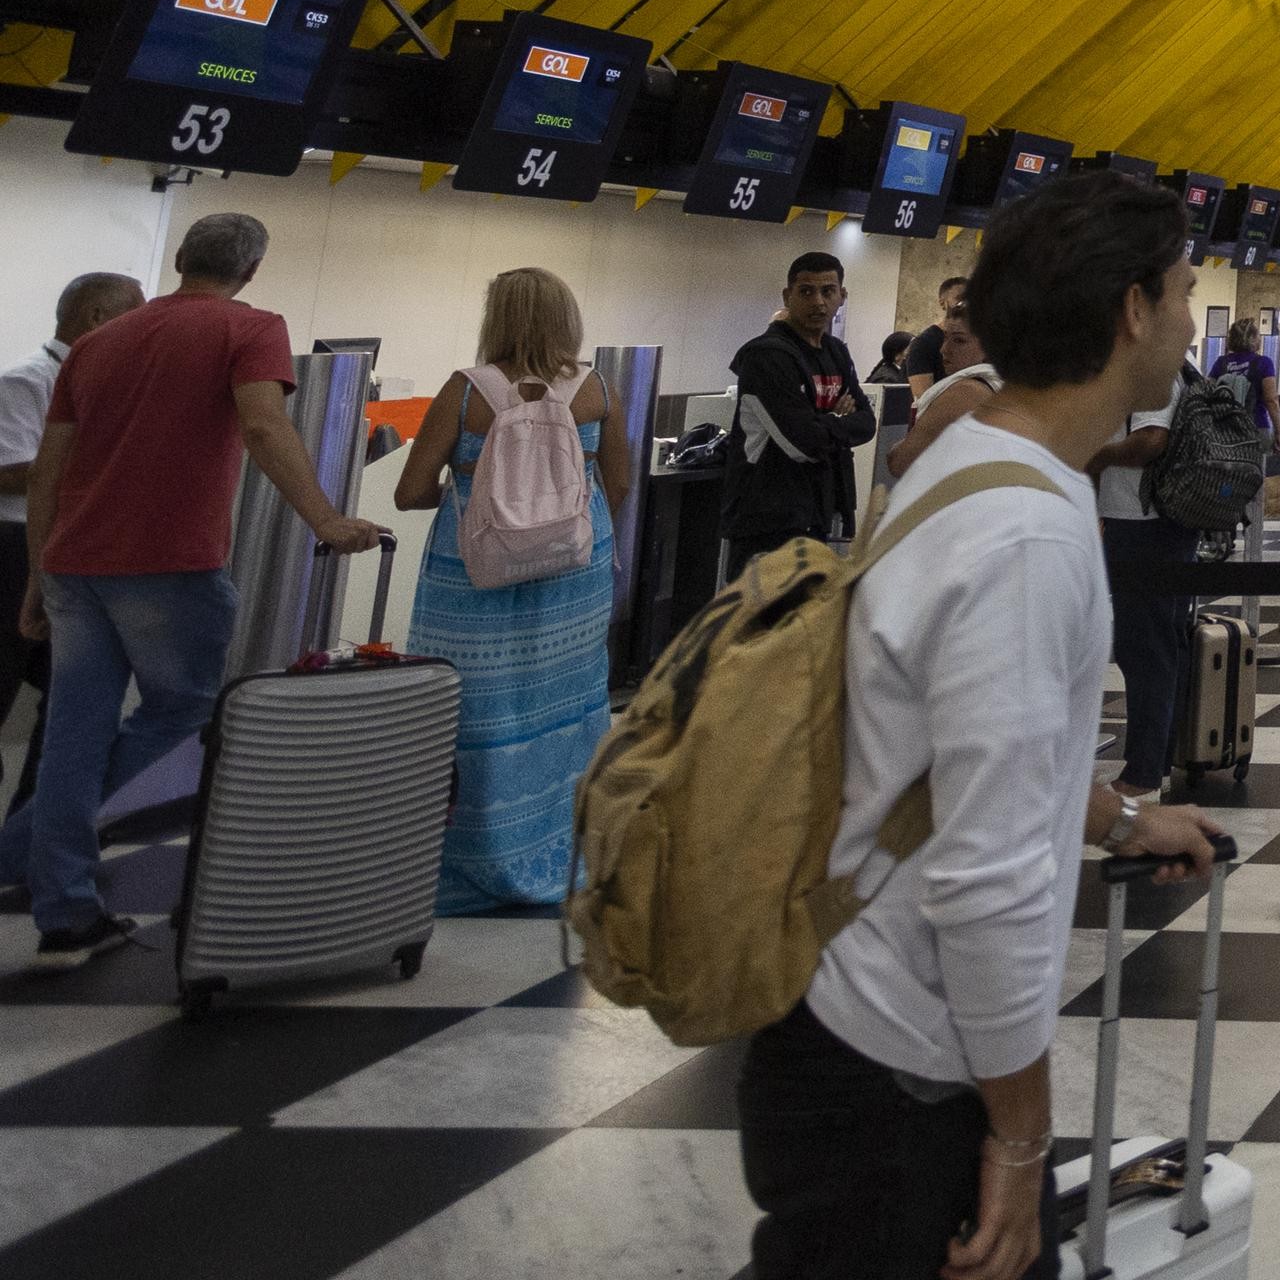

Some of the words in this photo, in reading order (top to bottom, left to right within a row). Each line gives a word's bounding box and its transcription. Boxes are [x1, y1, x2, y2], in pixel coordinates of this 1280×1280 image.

[306, 11, 329, 24] CK53
[198, 62, 257, 84] SERVICES
[542, 54, 569, 75] GOL
[752, 99, 772, 116] GOL
[171, 105, 231, 154] 53
[535, 113, 573, 129] SERVICES
[746, 149, 774, 161] SERVICES
[517, 148, 557, 187] 54
[729, 177, 760, 211] 55
[895, 199, 917, 229] 56
